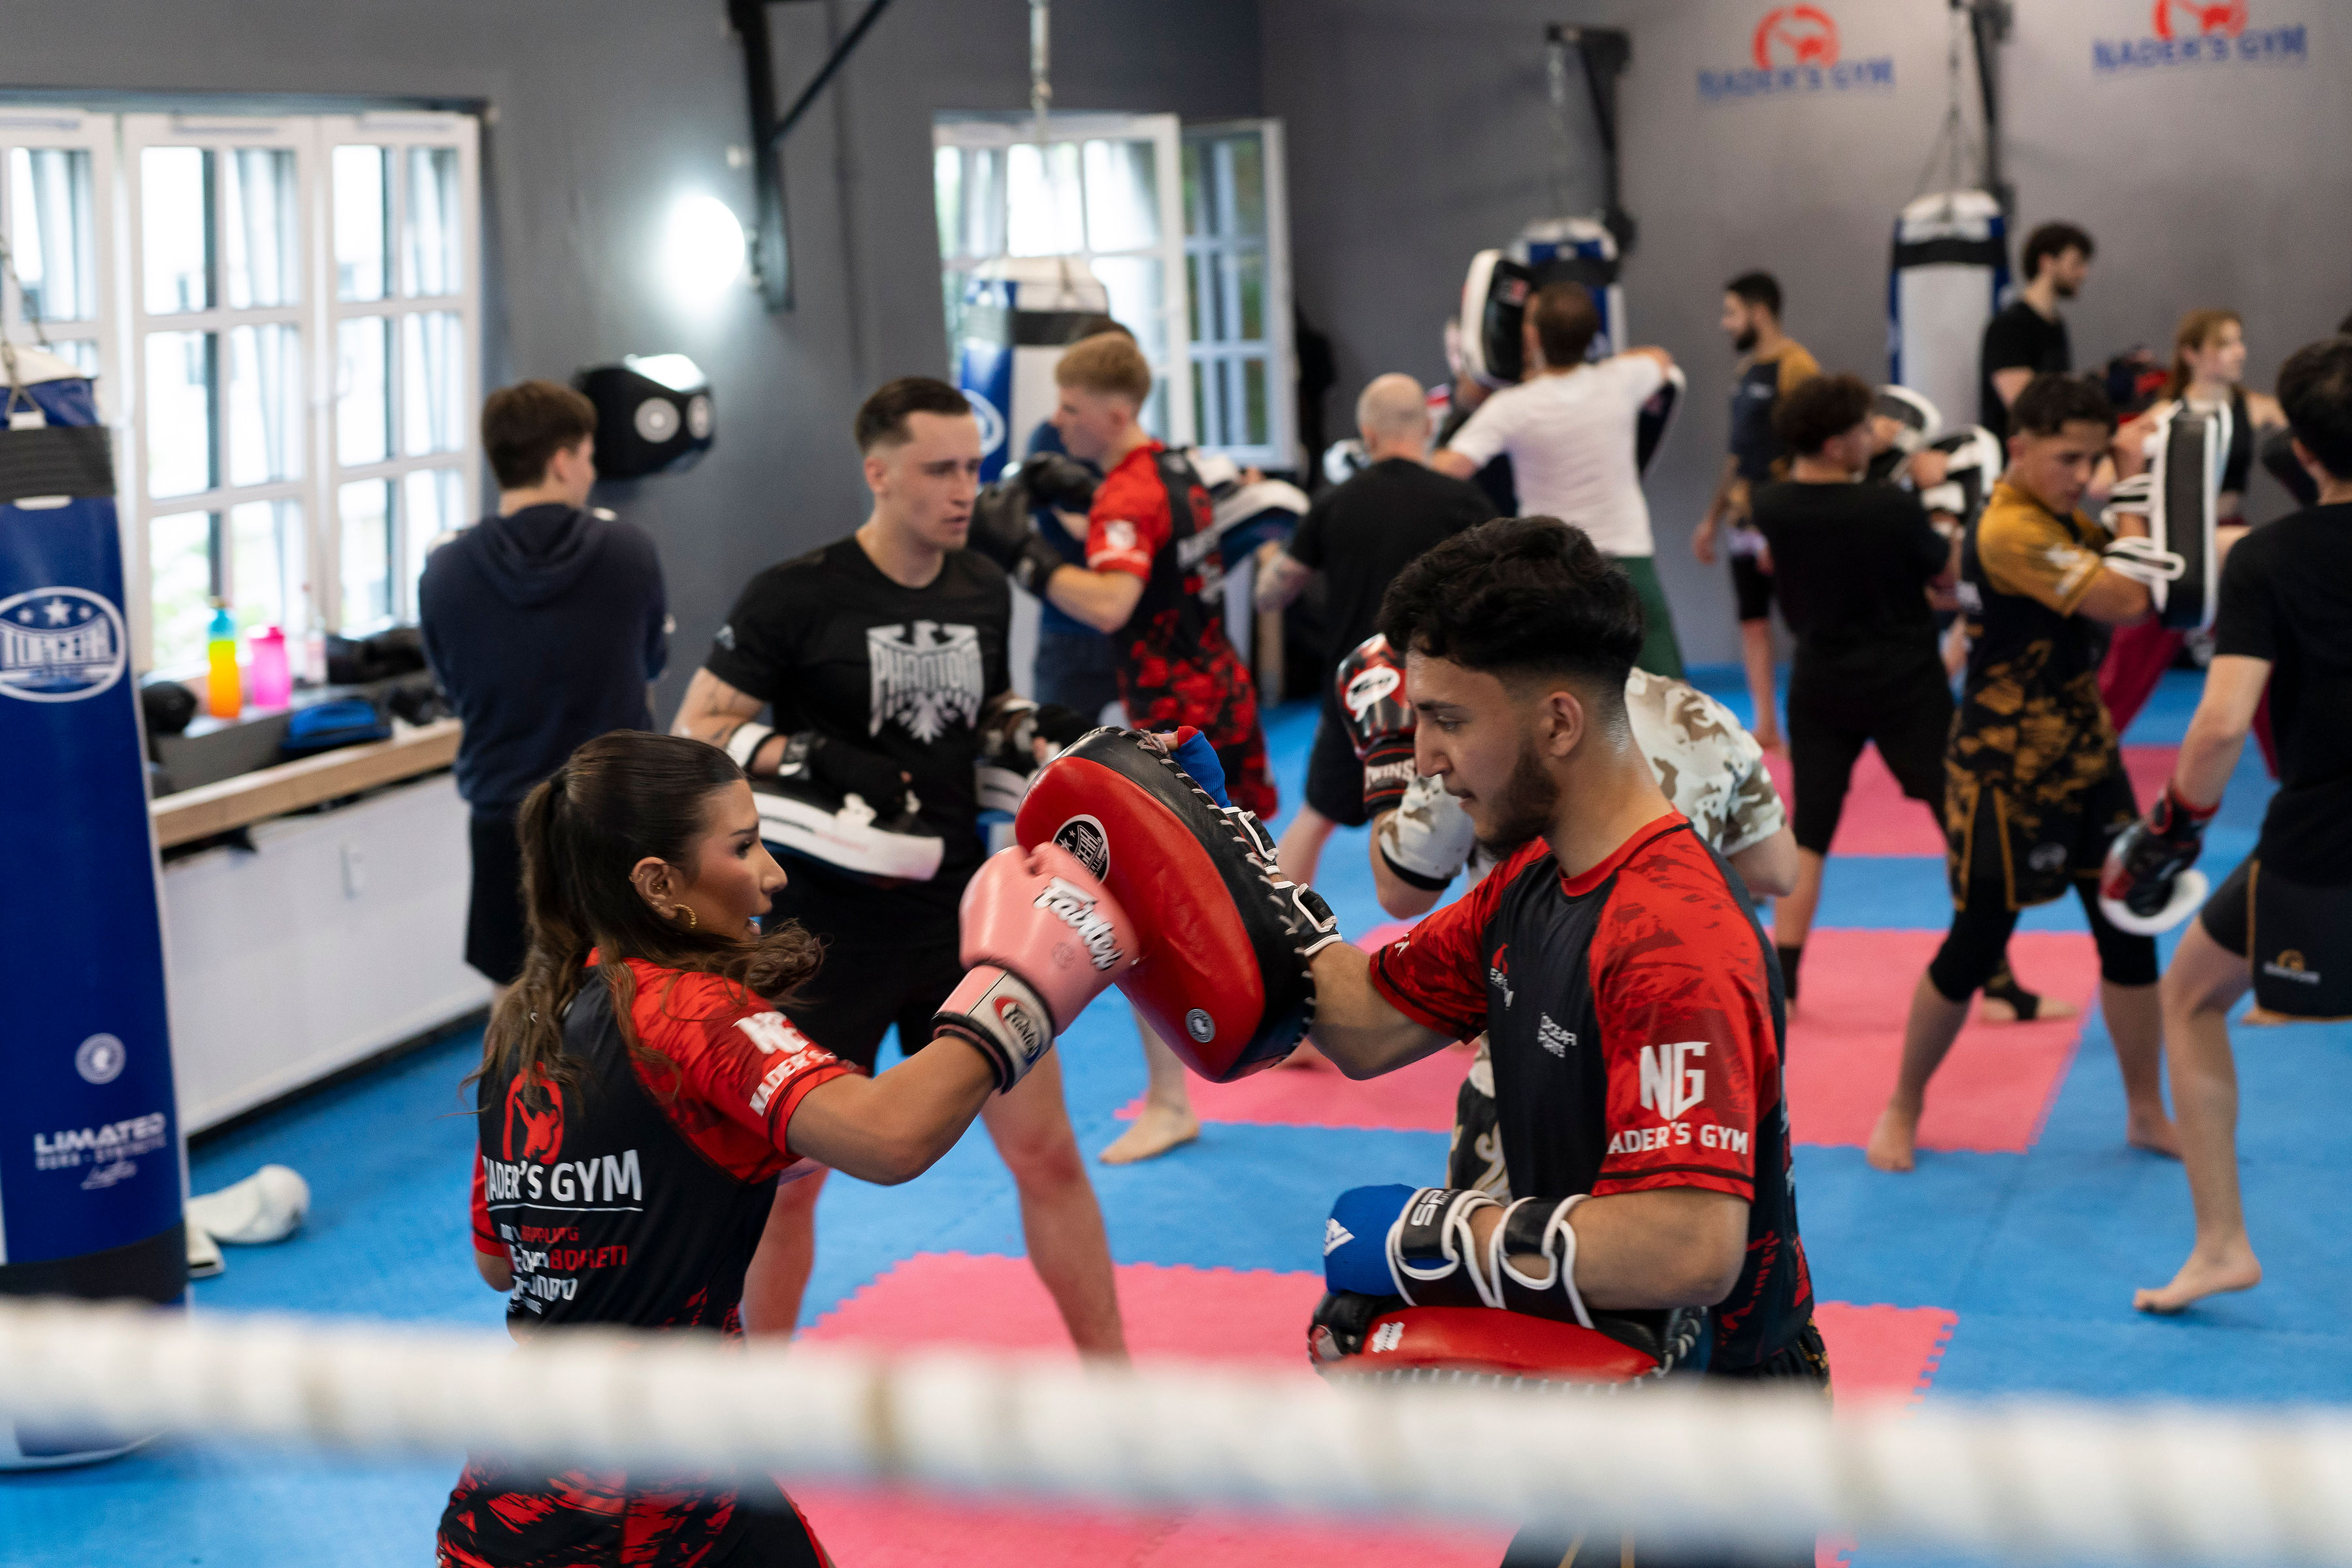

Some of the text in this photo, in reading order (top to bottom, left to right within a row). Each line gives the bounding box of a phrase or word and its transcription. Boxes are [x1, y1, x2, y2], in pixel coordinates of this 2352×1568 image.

[1640, 1041, 1710, 1121] NG
[1607, 1120, 1748, 1154] ADER'S GYM
[550, 1149, 642, 1202] GYM
